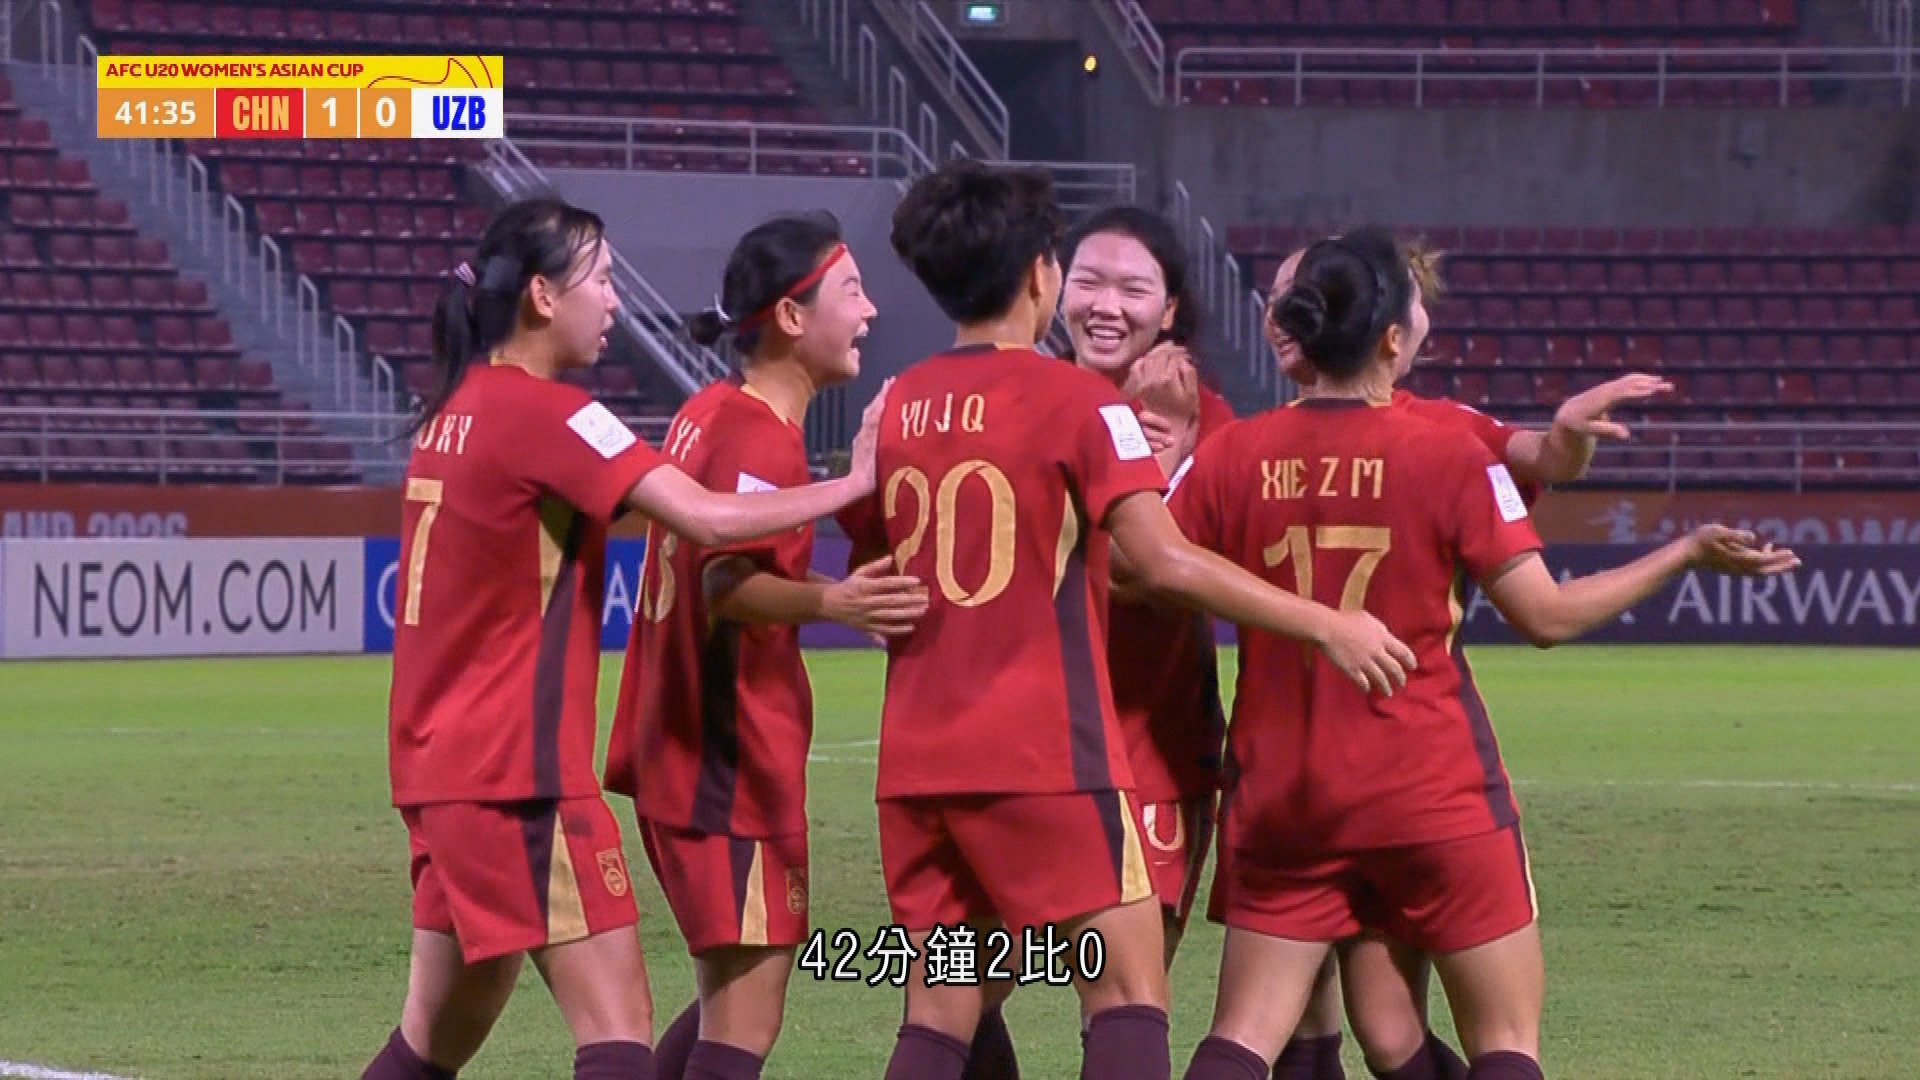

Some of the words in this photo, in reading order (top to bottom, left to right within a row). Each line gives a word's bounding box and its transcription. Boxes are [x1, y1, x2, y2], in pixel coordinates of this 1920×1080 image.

[901, 398, 930, 440] YU
[935, 392, 953, 432] J
[962, 393, 985, 432] Q
[1261, 459, 1308, 499] XIE
[1318, 456, 1340, 497] Z
[1350, 457, 1385, 499] M
[403, 477, 443, 625] 7
[884, 459, 1016, 607] 20
[1263, 525, 1391, 613] 17
[34, 559, 337, 637] NEOM.COM
